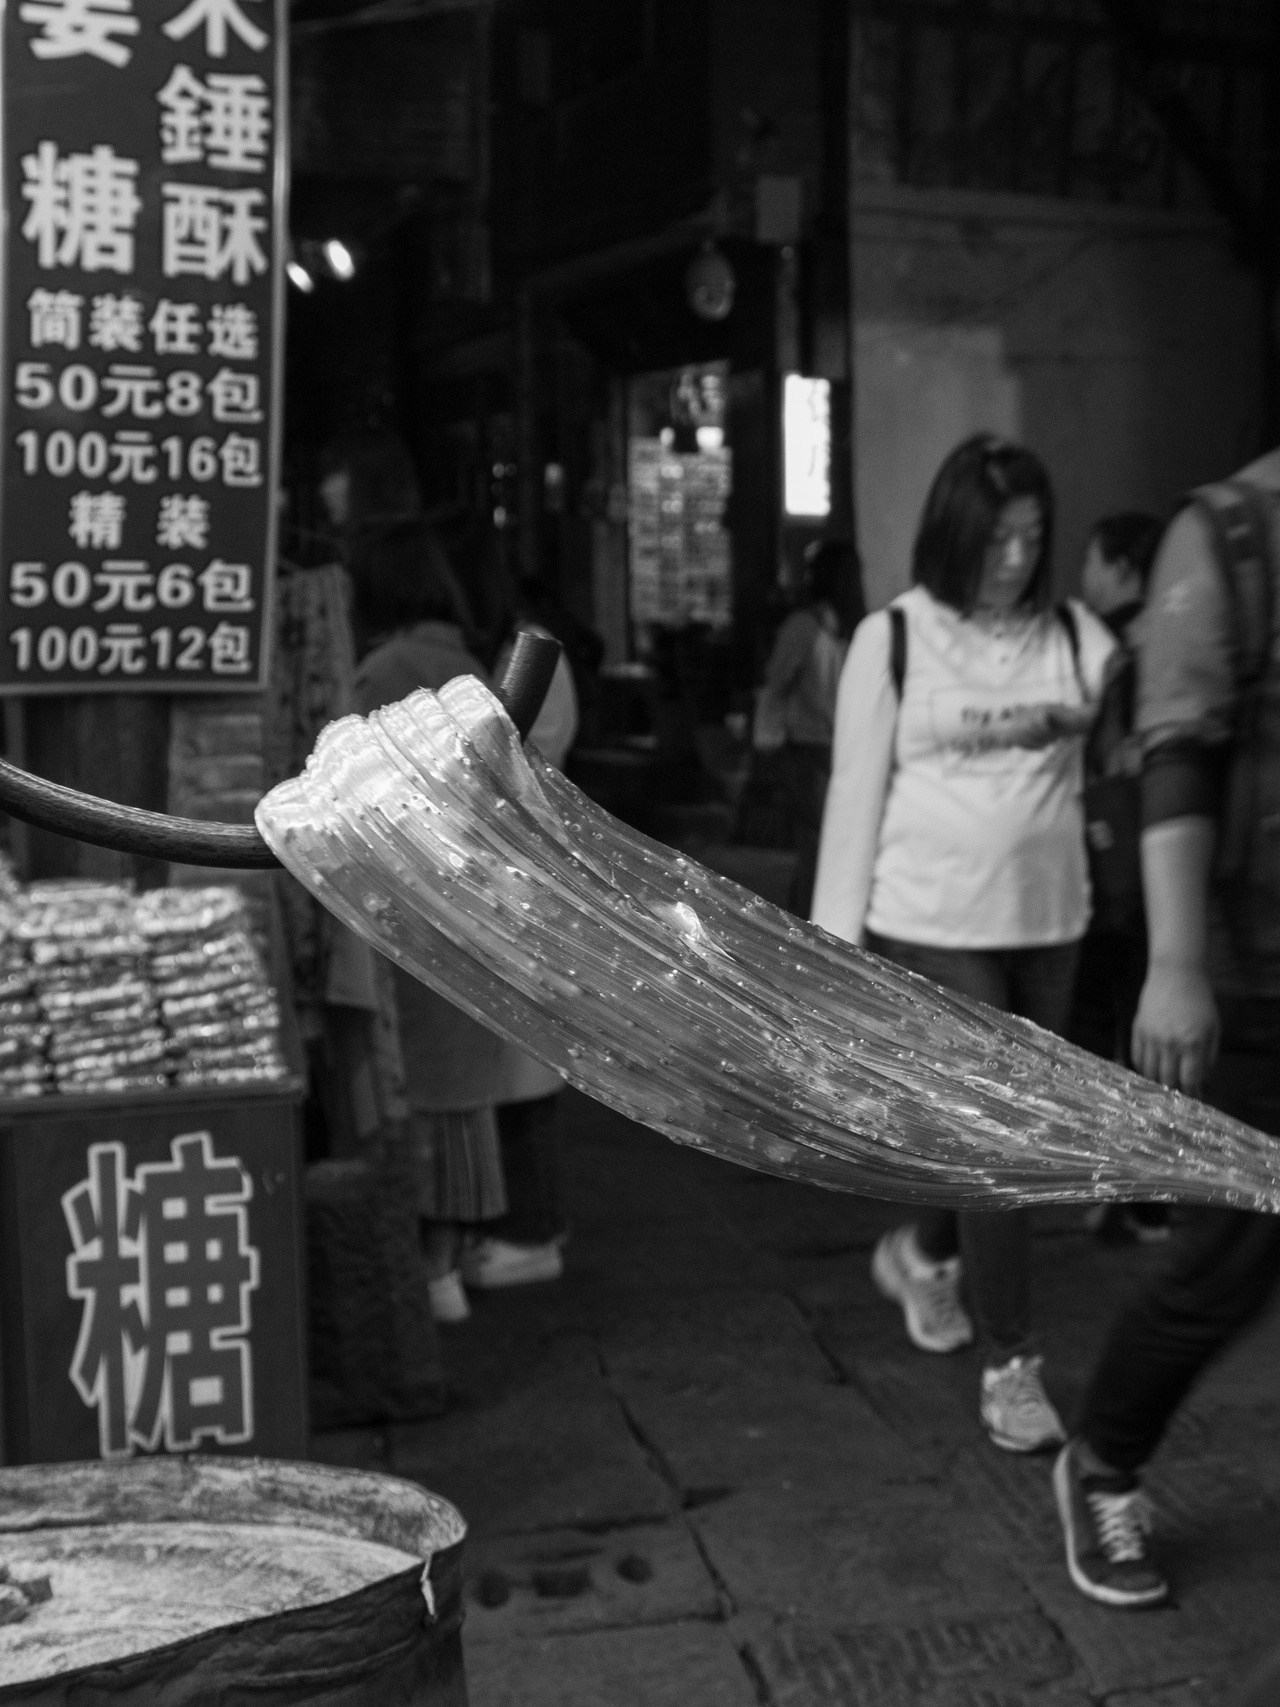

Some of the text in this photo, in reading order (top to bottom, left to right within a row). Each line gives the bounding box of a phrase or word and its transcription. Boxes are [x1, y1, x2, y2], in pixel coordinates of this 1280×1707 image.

[27, 288, 257, 359] 简装任选
[15, 362, 263, 423] 50元8包
[16, 429, 262, 487] 100元16包
[10, 559, 255, 612] 50元6包
[10, 622, 251, 674] 100元12包
[62, 1132, 260, 1457] 糖
